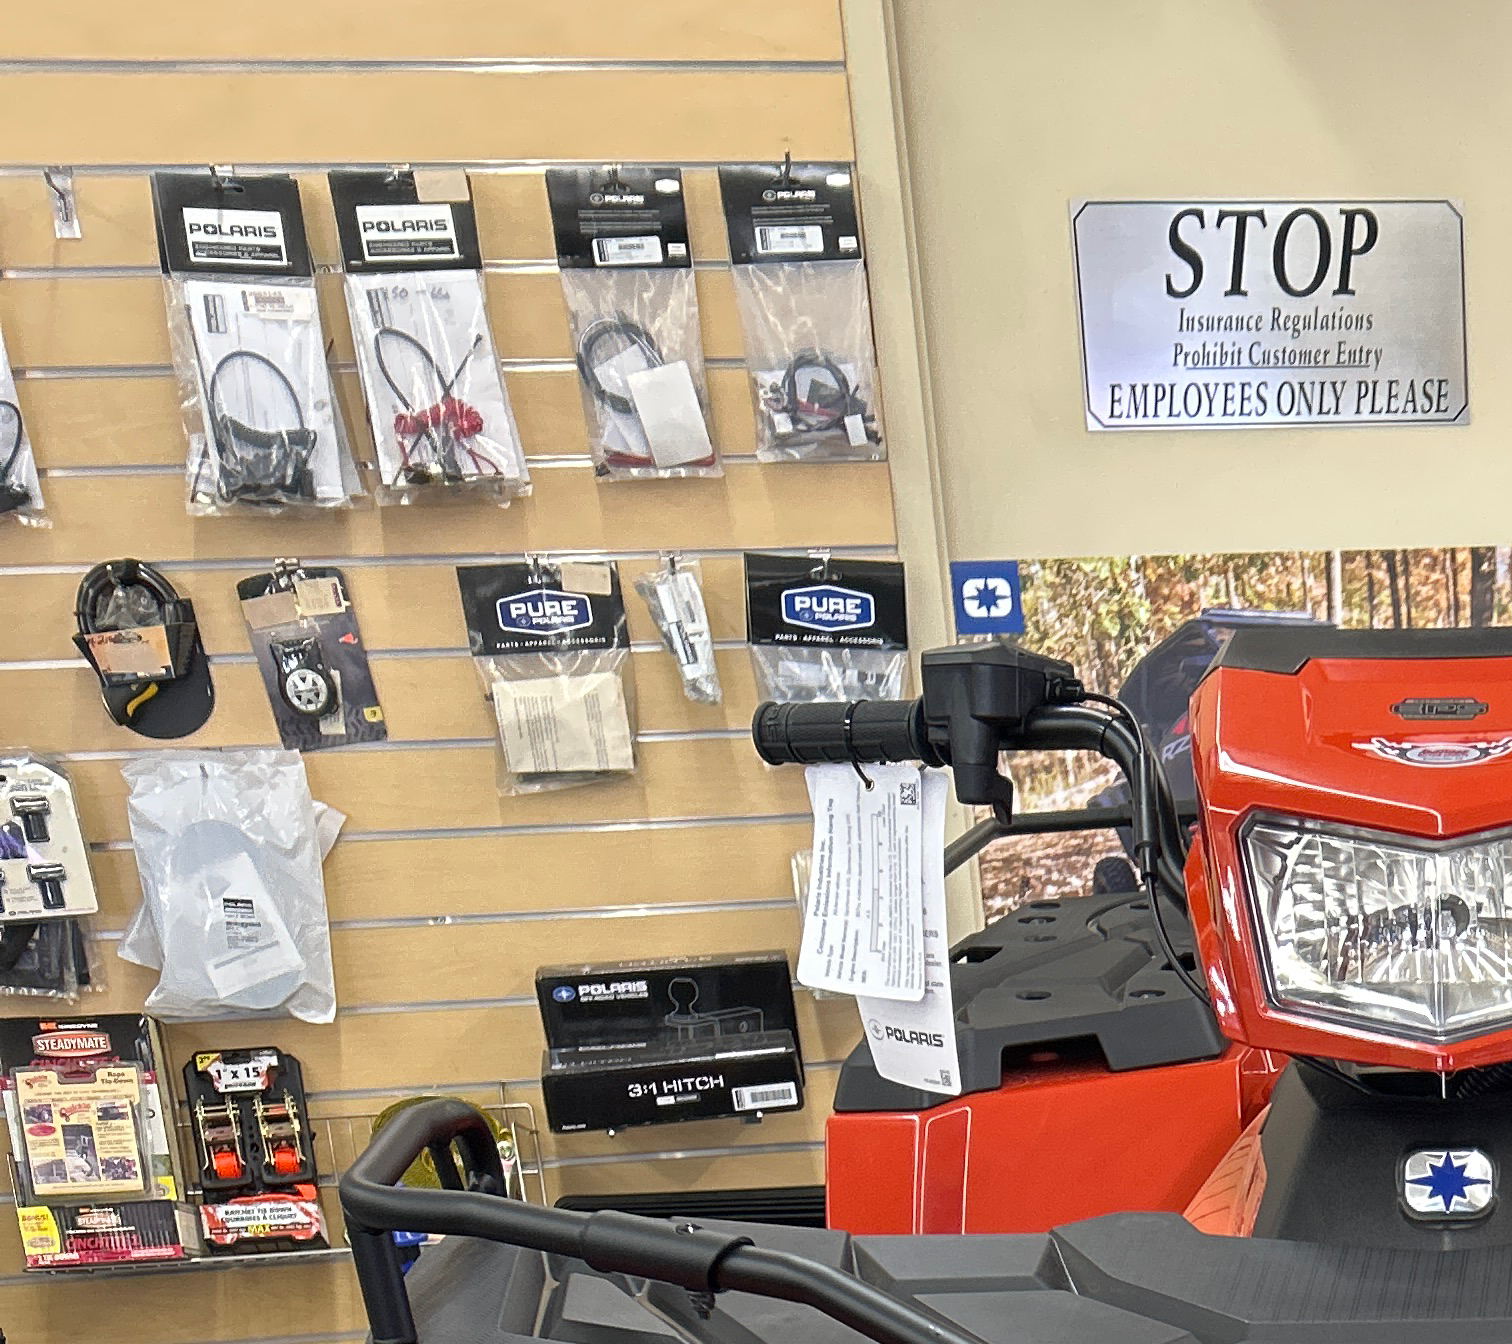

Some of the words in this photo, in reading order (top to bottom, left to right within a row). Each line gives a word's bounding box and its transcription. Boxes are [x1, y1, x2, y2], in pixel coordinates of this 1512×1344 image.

[189, 222, 278, 238] POLARIS
[362, 219, 449, 233] POLARIS
[1165, 207, 1380, 298] STOP
[1178, 307, 1263, 333] Insurance
[1270, 306, 1374, 339] Regulations
[1173, 342, 1242, 367] Prohibit
[1248, 341, 1331, 367] Customer
[1335, 342, 1383, 371] Entry
[1108, 382, 1268, 420] EMPLOYEES
[1276, 380, 1347, 417] ONLY
[1354, 378, 1450, 415] PLEASE
[509, 600, 579, 619] PURE
[794, 596, 862, 614] PURE
[1161, 734, 1191, 764] RZ
[577, 981, 648, 996] POLARIS
[36, 1036, 107, 1051] STEADYMATE
[885, 1025, 945, 1047] POLARIS
[627, 1079, 657, 1098] 3:1
[662, 1074, 725, 1095] HITCH
[247, 1224, 271, 1234] MAX
